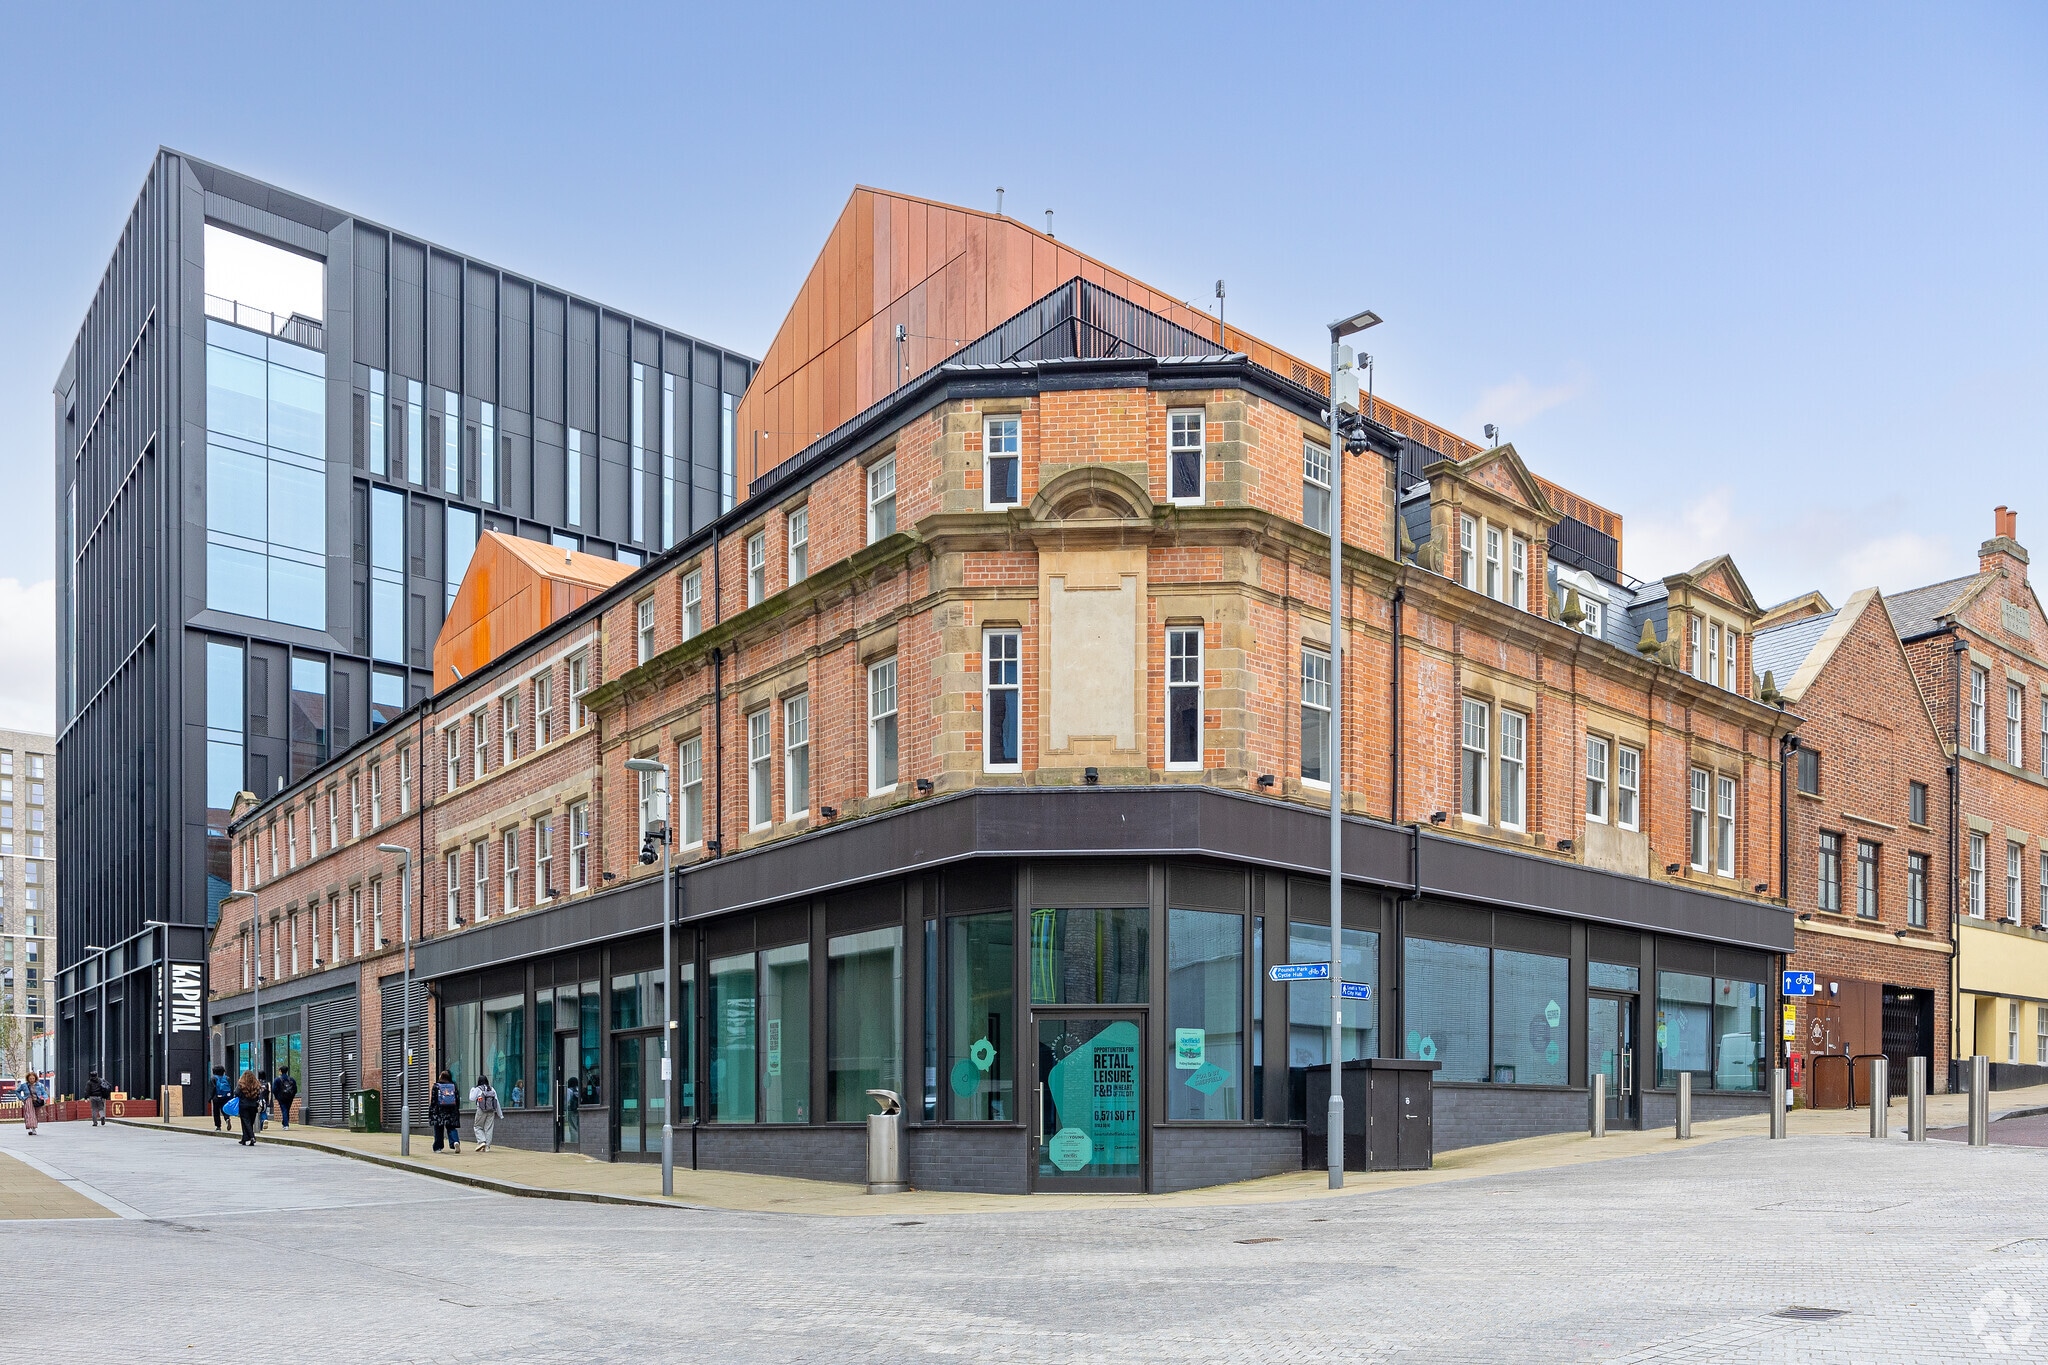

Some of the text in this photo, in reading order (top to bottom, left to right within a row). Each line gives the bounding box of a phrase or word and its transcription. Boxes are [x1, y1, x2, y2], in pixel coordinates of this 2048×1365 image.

[172, 964, 201, 1033] KAPITAL
[1094, 1053, 1134, 1070] RETAIL,
[1094, 1070, 1135, 1084] LEISURE,
[1094, 1084, 1112, 1097] F&B
[1094, 1110, 1136, 1123] 6,571 SQ FT
